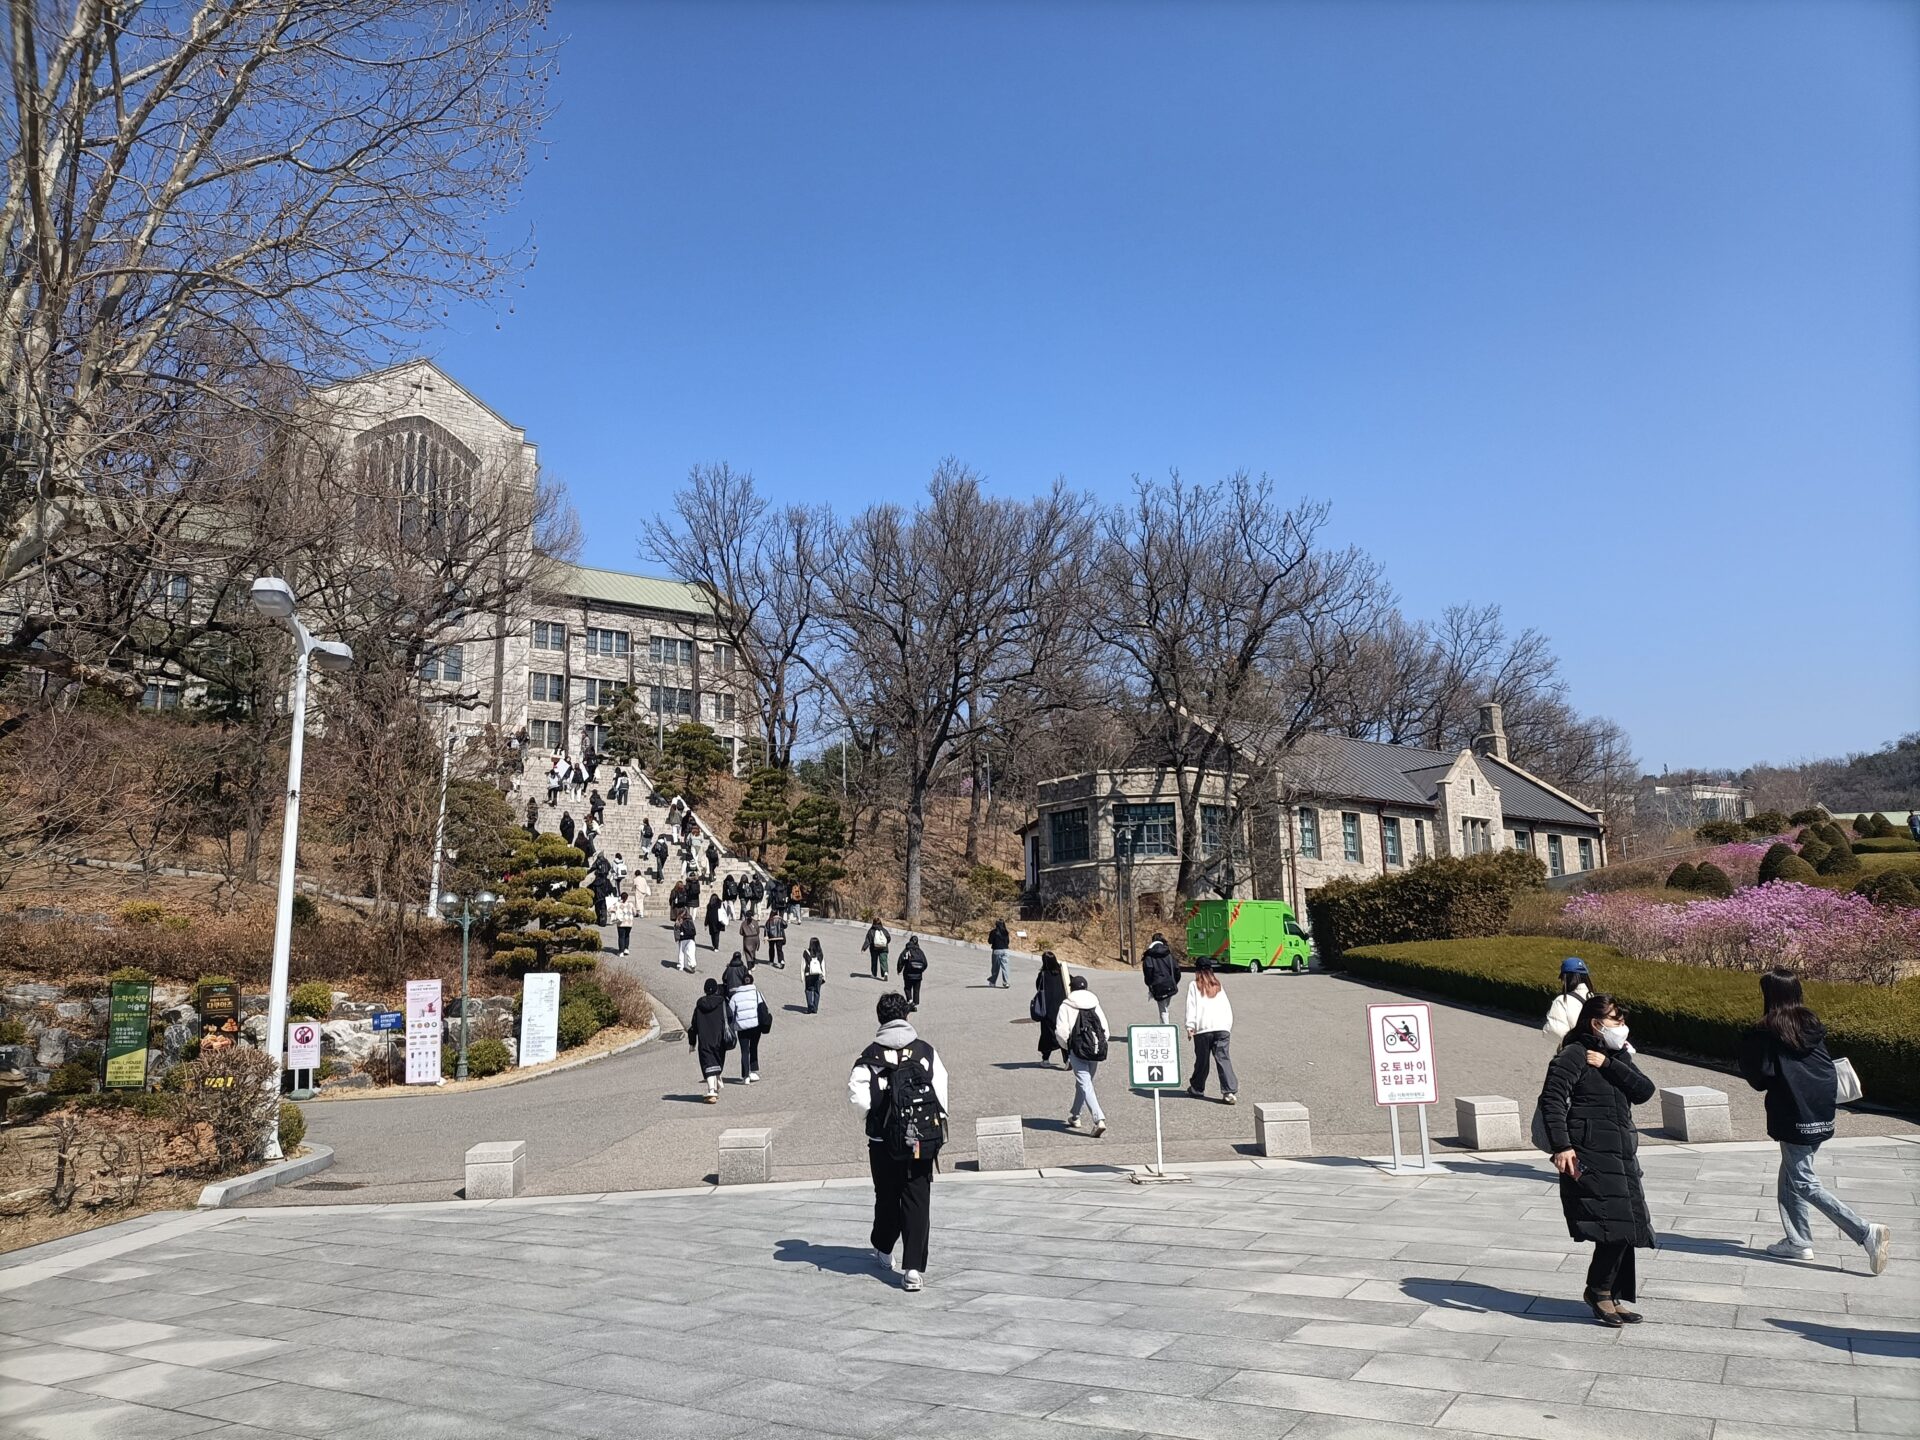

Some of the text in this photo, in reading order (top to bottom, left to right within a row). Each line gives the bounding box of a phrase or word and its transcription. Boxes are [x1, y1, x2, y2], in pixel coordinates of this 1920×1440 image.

[1139, 1049, 1170, 1059] 대강당
[1380, 1061, 1426, 1072] 오토바이
[1381, 1074, 1427, 1086] 진입금지
